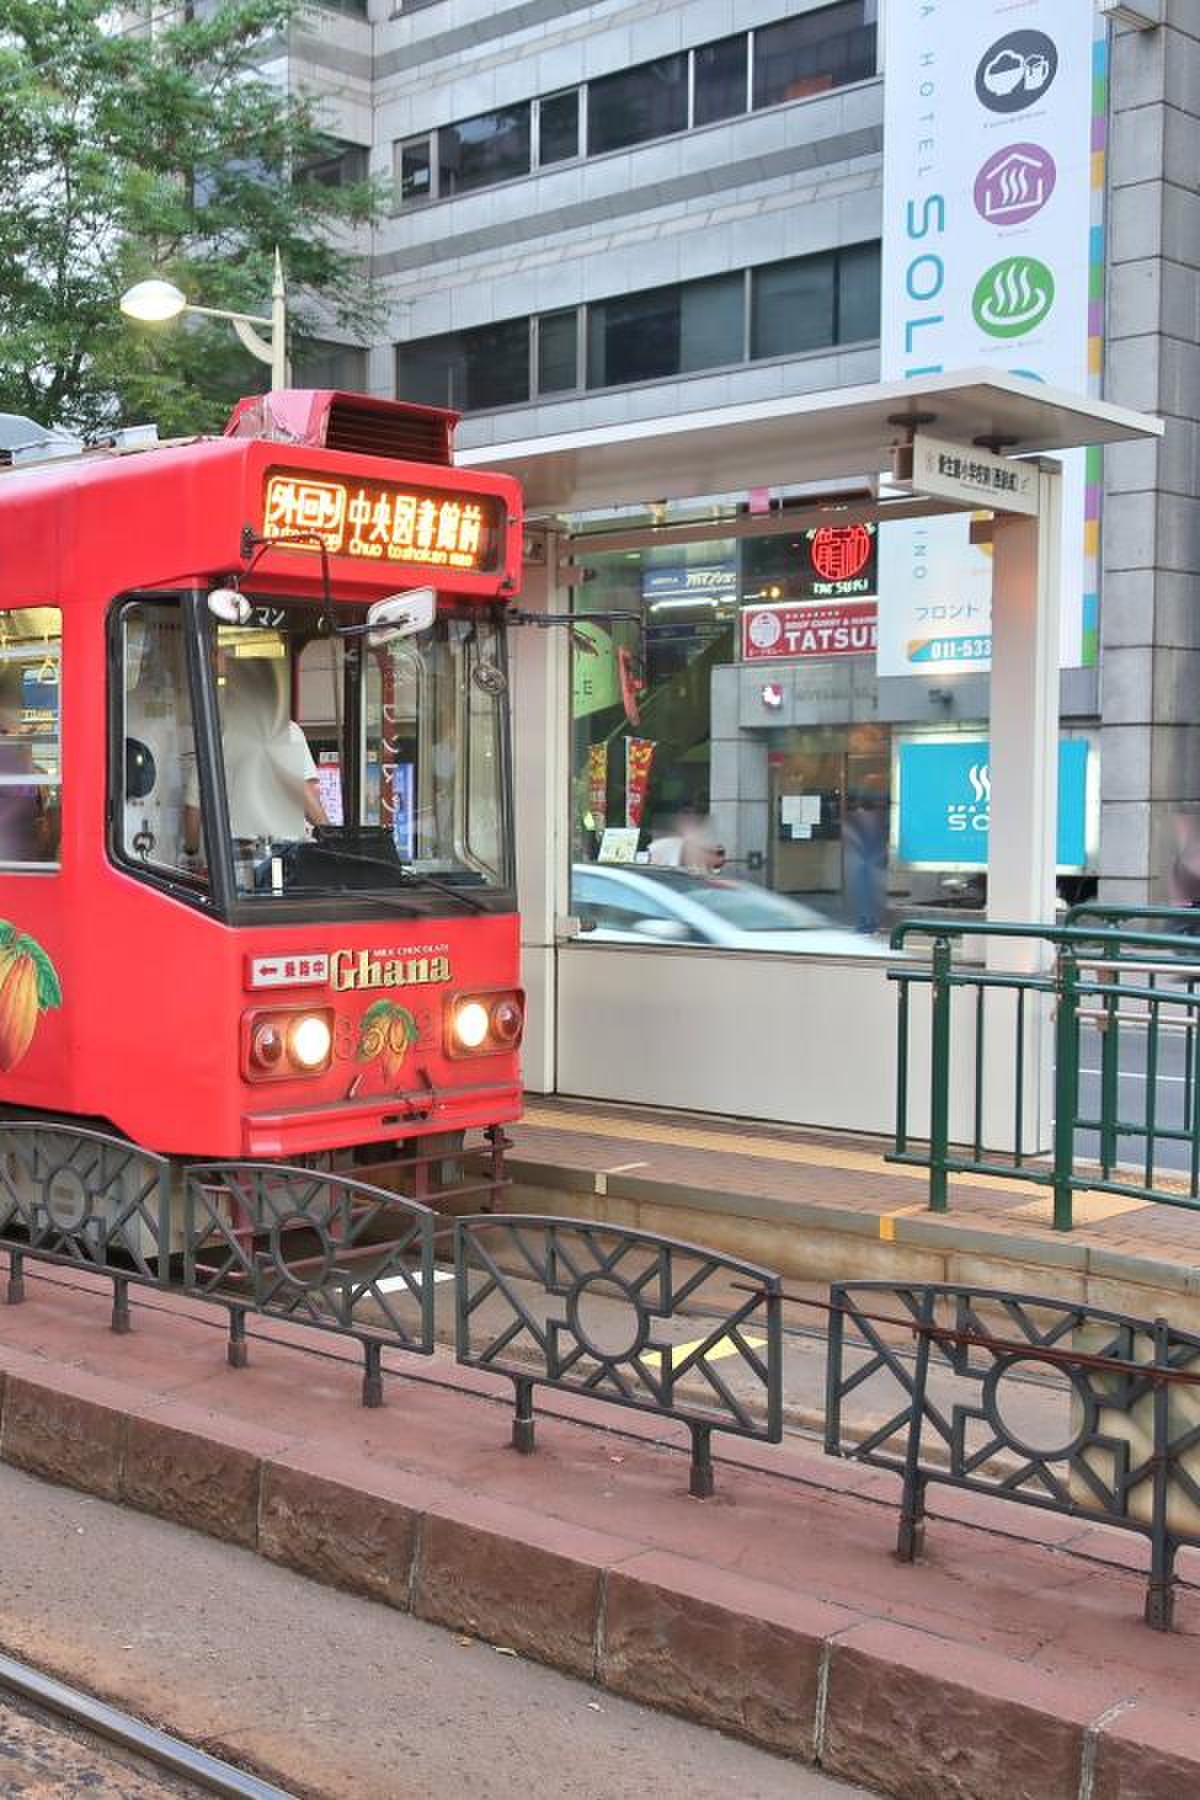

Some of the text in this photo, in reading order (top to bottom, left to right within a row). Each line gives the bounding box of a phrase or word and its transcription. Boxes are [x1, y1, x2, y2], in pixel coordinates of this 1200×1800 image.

[917, 51, 936, 177] HOTEL
[905, 193, 944, 379] SOL
[272, 483, 481, 552] 外回り 中央図書館前
[350, 540, 383, 558] Chuo
[913, 603, 979, 622] フロント
[331, 949, 453, 992] Ghana
